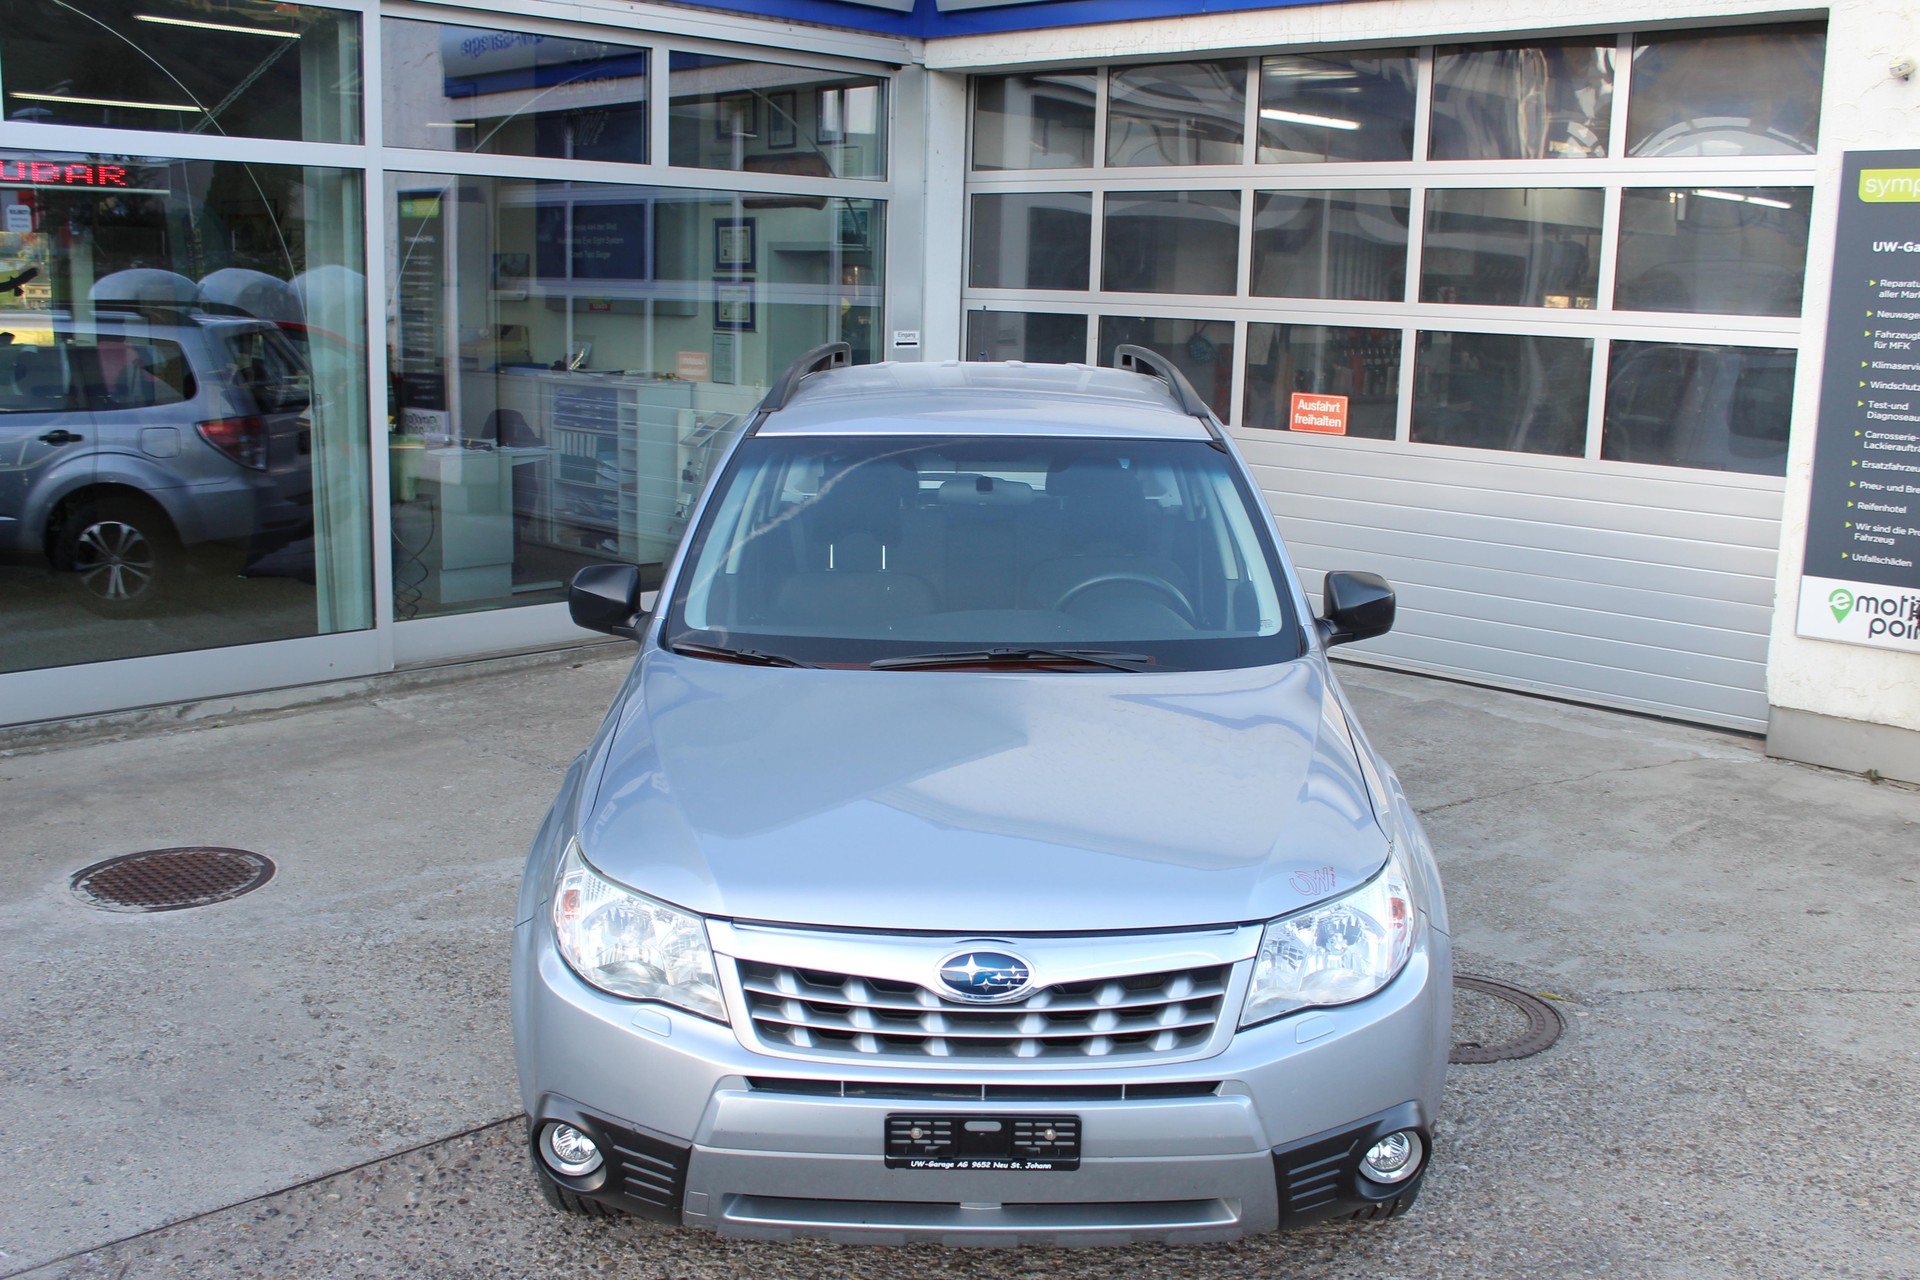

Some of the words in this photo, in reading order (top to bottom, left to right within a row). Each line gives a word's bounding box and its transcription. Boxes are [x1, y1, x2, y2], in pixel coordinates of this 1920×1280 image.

[1872, 241, 1920, 253] UW-Ga
[1878, 290, 1899, 298] aller
[1873, 341, 1888, 349] für
[1888, 342, 1911, 350] MFK
[1297, 398, 1341, 413] Ausfahrt
[1868, 400, 1909, 411] Test-und
[1294, 413, 1342, 428] freihalten
[1866, 411, 1920, 422] Diagnoseau
[1859, 481, 1885, 491] Pneu-
[1857, 501, 1907, 514] Reifenhotel
[1855, 522, 1871, 531] Wir
[1872, 524, 1891, 533] sind
[1891, 526, 1907, 535] die
[1854, 532, 1895, 546] Fahrzeug
[1852, 553, 1912, 567] Unfallschäden
[910, 1160, 955, 1170] UW-Garage
[956, 1161, 969, 1169] AG
[971, 1161, 991, 1169] 9652
[992, 1161, 1009, 1169] Neu
[1010, 1162, 1023, 1170] St.
[1024, 1162, 1052, 1170] Johann
